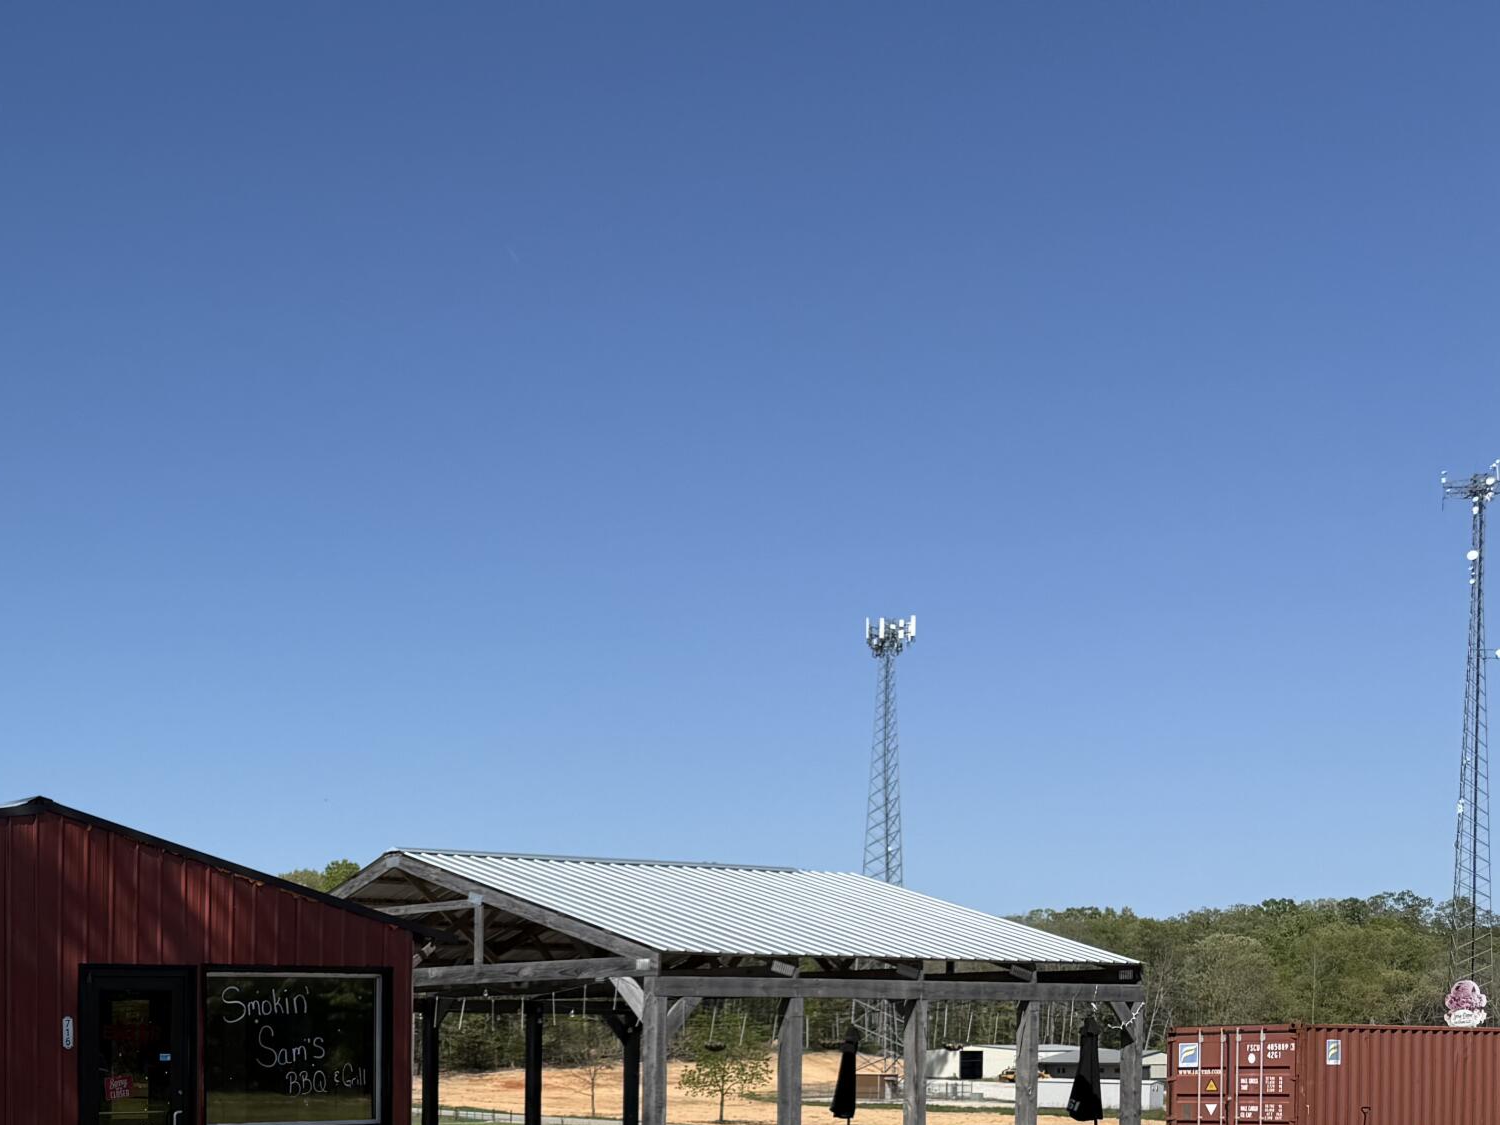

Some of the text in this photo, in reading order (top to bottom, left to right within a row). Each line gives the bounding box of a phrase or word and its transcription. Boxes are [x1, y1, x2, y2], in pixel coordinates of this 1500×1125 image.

[221, 986, 310, 1023] Smokin'
[285, 1070, 329, 1098] BBQ
[342, 1062, 367, 1088] Grill
